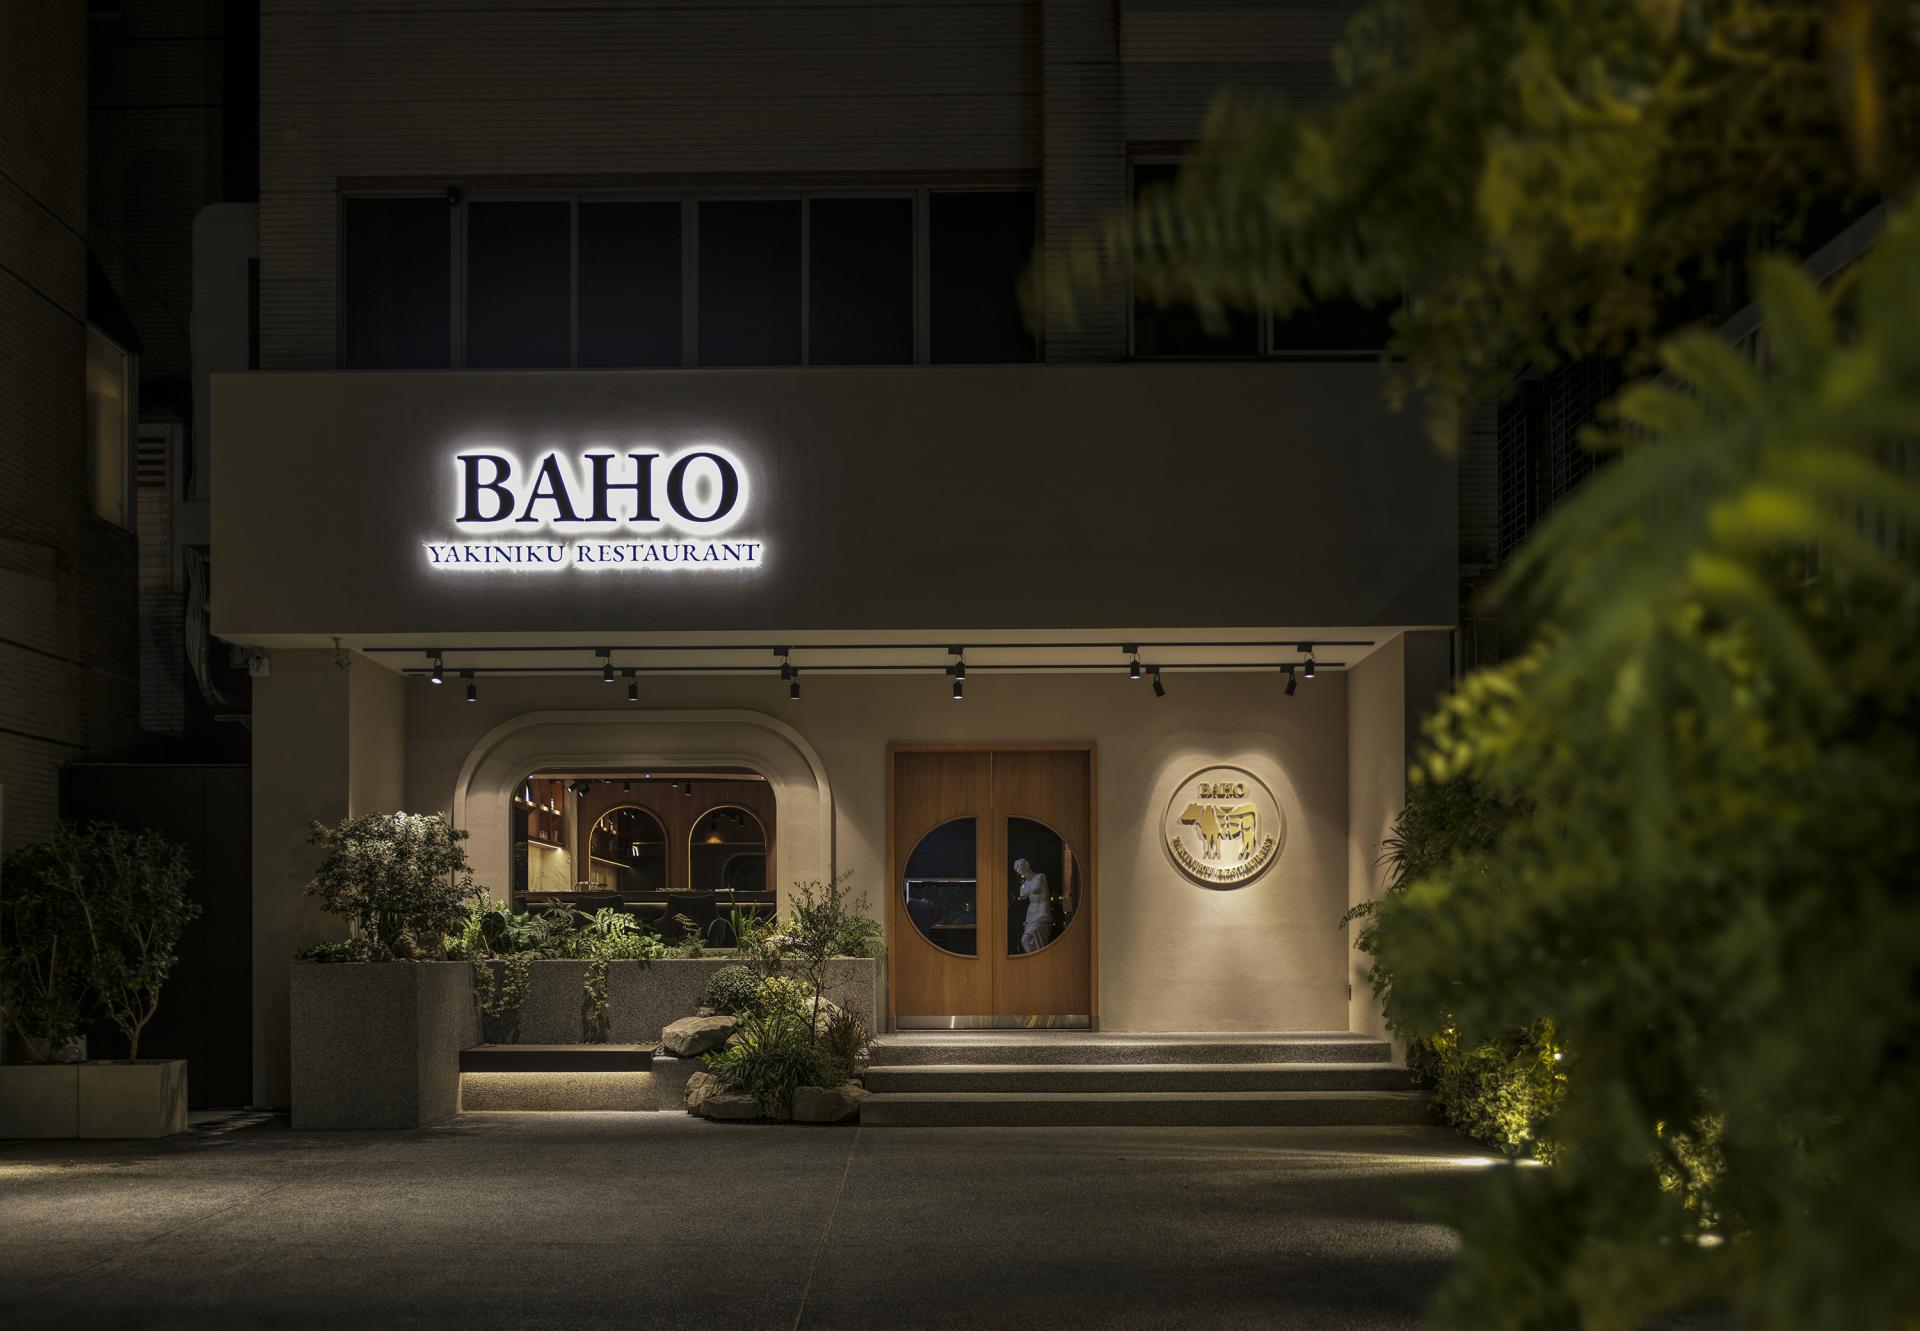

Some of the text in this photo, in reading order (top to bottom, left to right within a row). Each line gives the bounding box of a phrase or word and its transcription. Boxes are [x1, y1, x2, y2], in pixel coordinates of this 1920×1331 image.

[456, 452, 738, 522] BAHO
[429, 543, 760, 563] YAKINIKU RESTAURANT
[1200, 783, 1247, 797] BAHO
